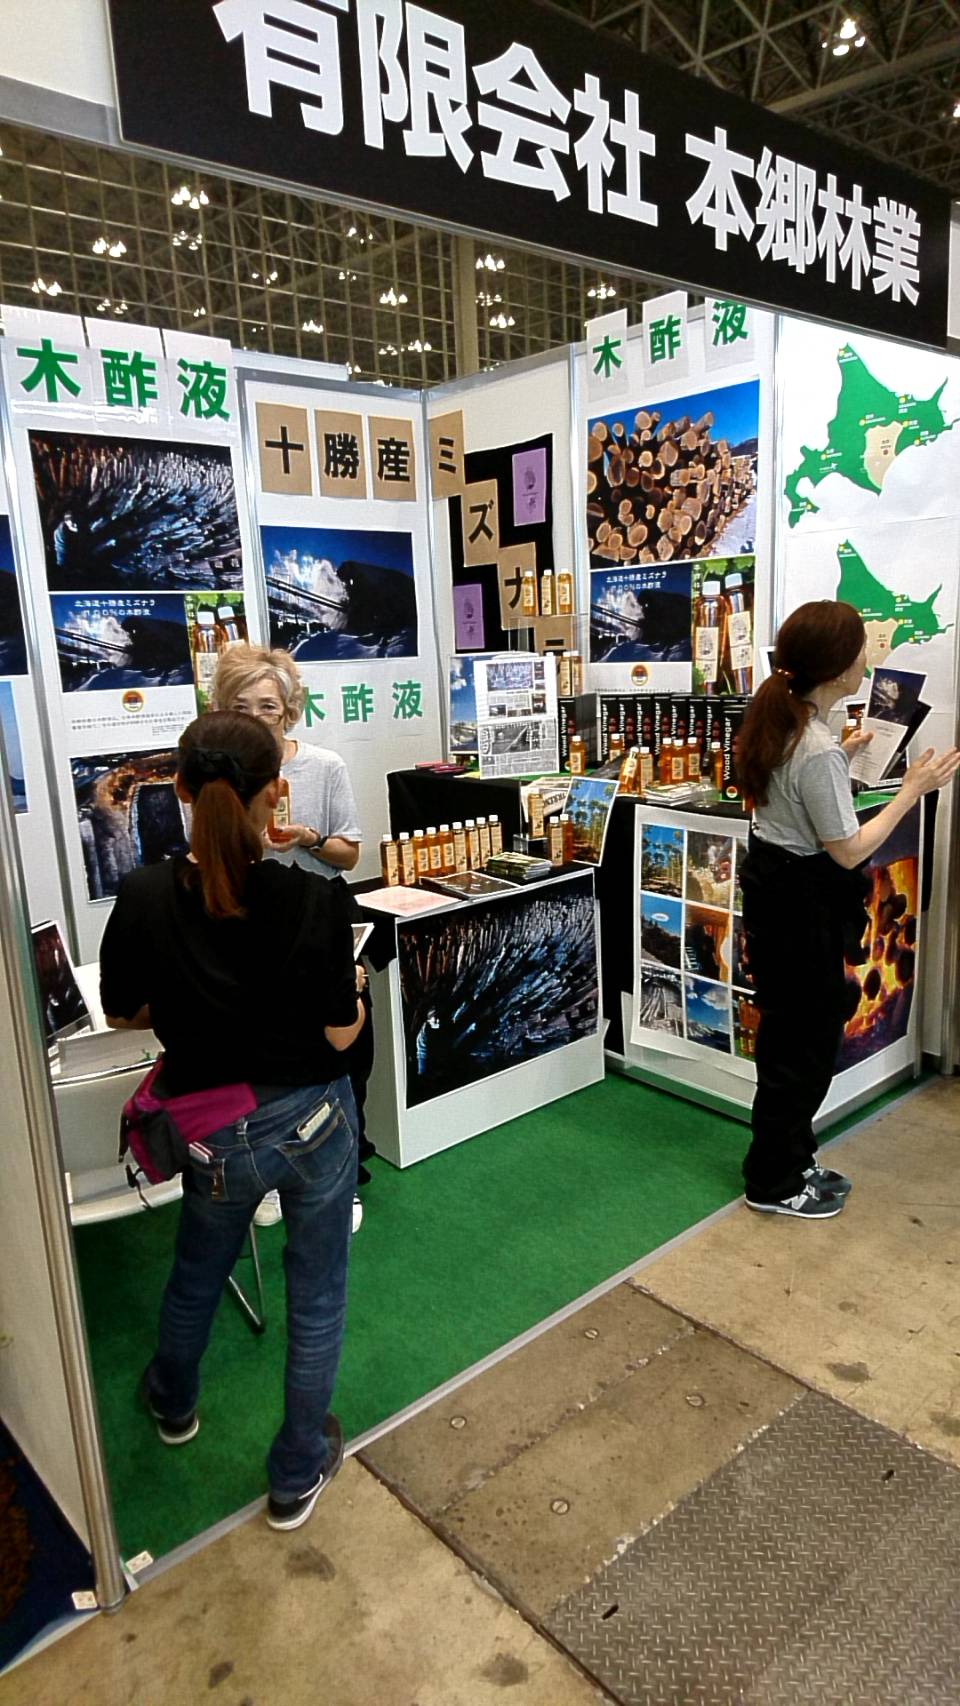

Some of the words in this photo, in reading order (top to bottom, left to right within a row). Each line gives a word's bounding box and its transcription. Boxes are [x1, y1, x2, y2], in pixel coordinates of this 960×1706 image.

[212, 0, 659, 227] 有限会社
[685, 126, 921, 306] 本郷林業
[592, 300, 749, 378] 木酢液
[16, 338, 230, 421] 木酢液
[265, 426, 411, 482] 十勝産
[303, 680, 423, 728] 木酢液
[724, 717, 732, 752] Vinegar
[723, 753, 731, 780] Wood
